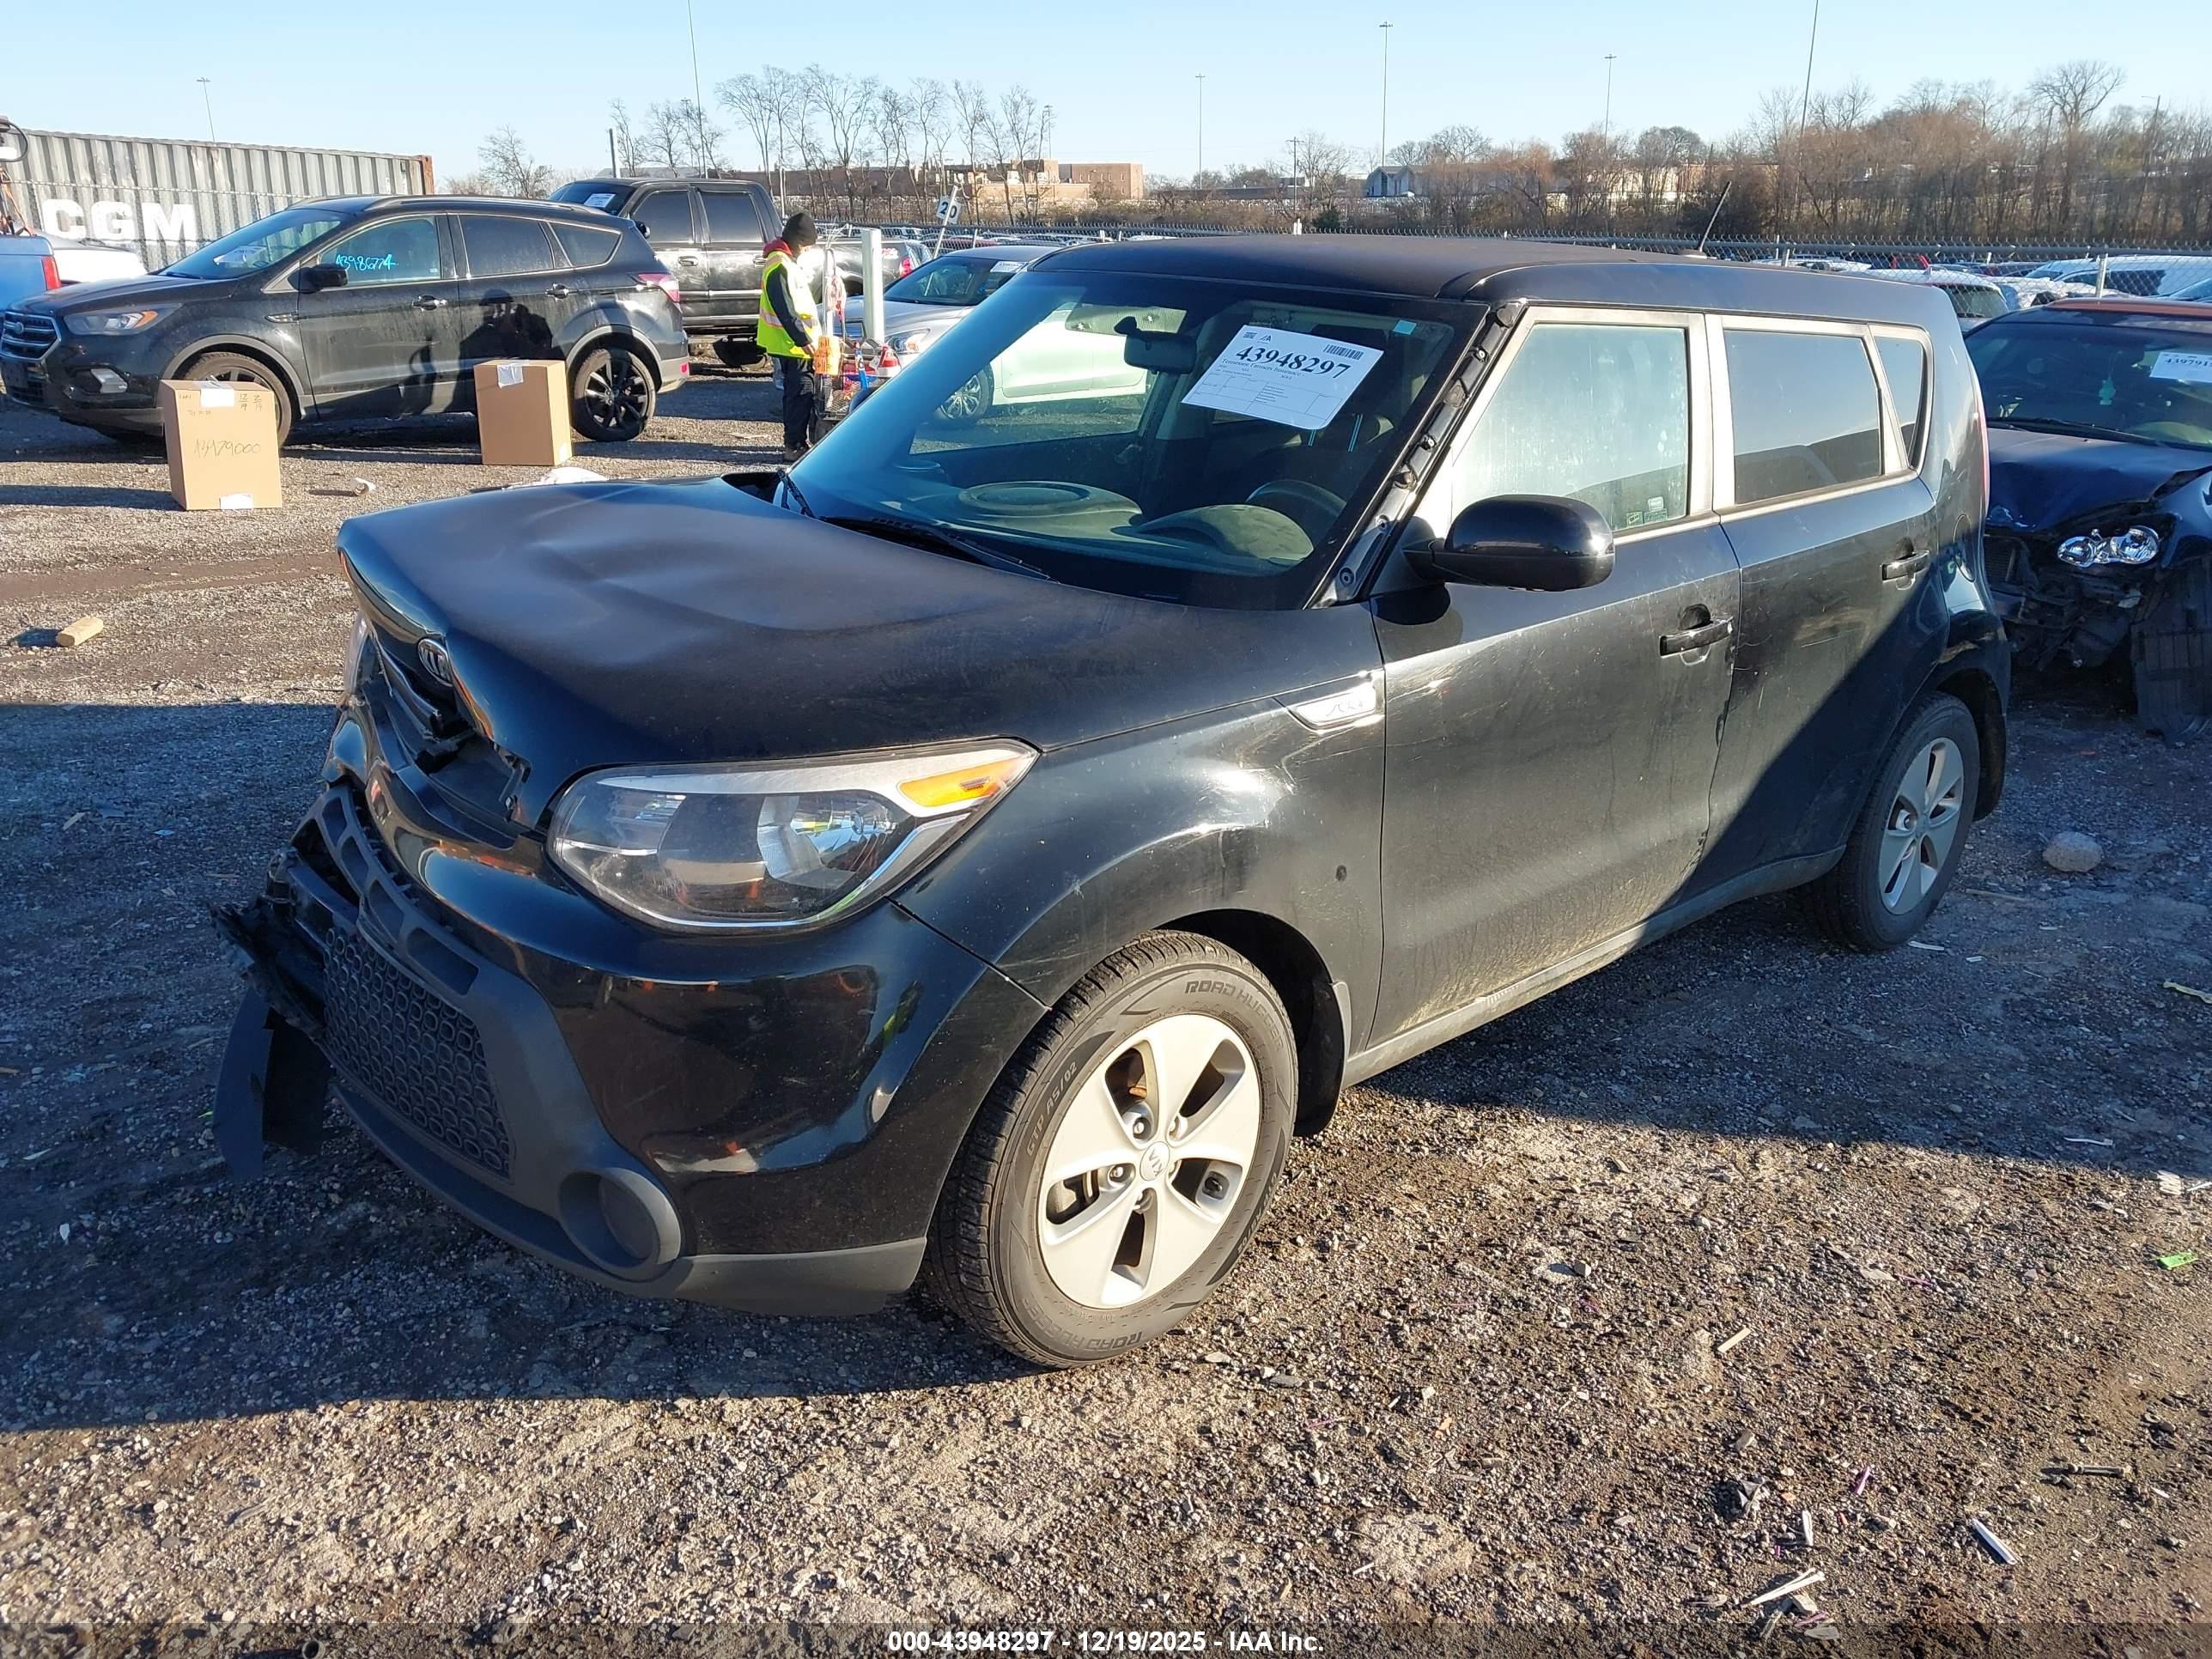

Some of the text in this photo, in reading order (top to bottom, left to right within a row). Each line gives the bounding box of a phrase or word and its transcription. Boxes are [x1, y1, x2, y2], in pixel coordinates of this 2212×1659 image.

[42, 198, 198, 246] CGM
[939, 201, 957, 219] 20
[1236, 345, 1352, 379] 43948297
[1185, 980, 1236, 996] ROAD
[1026, 1061, 1078, 1156] GTP AS/02
[1148, 1147, 1165, 1177] KIA
[1085, 1331, 1143, 1352] ROAD
